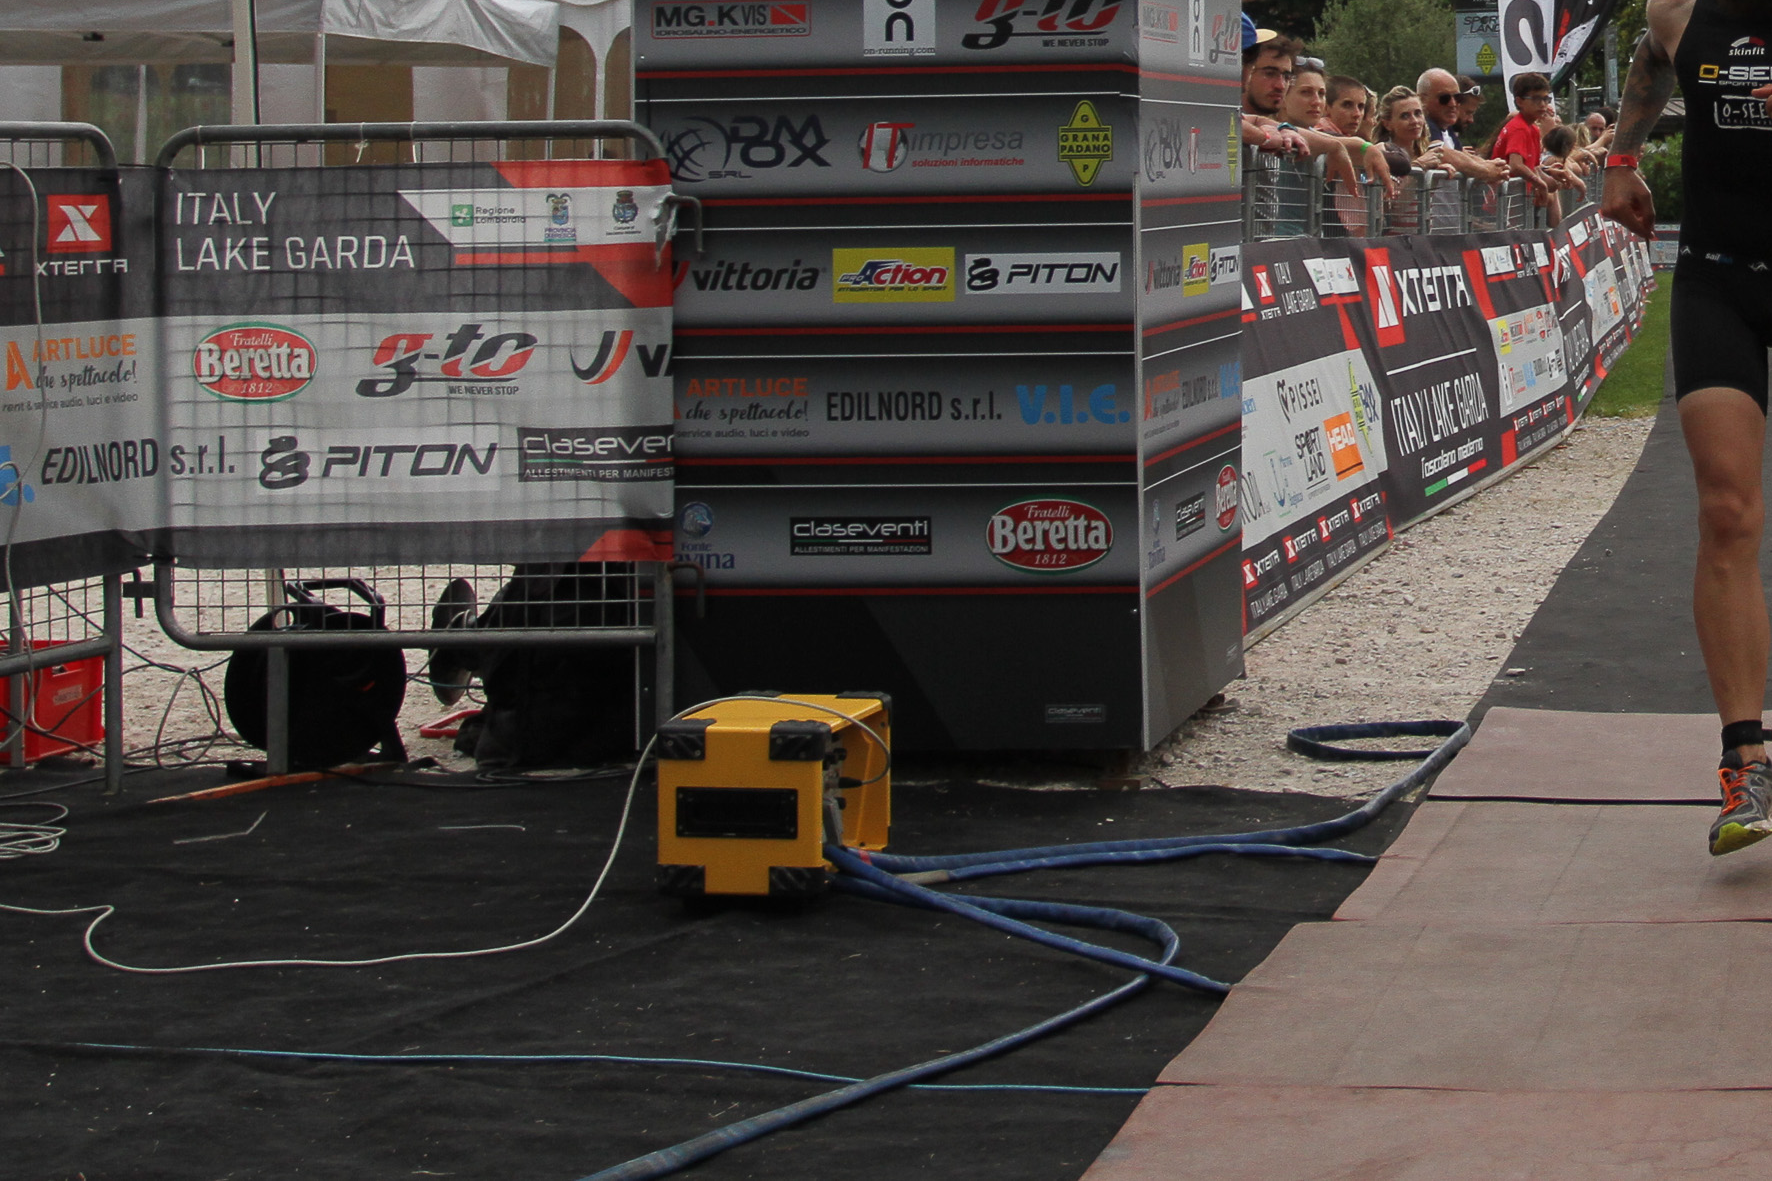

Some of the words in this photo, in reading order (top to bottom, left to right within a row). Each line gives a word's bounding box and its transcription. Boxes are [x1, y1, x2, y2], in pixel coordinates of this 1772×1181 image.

[863, 45, 937, 57] on-running.com
[1728, 46, 1765, 56] skinfit
[912, 158, 961, 168] soluzioni
[964, 156, 1025, 167] informatiche
[176, 191, 277, 226] ITALY
[176, 238, 270, 272] LAKE
[287, 235, 416, 271] GARDA
[1006, 262, 1119, 285] PITON
[1394, 265, 1472, 317] XTERRA
[61, 360, 138, 394] spettacolo!
[194, 342, 313, 382] Beretta
[686, 378, 808, 397] ARTLUCE
[1423, 380, 1460, 443] LAKE
[1453, 371, 1489, 431] GARDA
[749, 428, 768, 437] luci
[778, 427, 810, 438] video
[41, 438, 159, 486] EDILNORD
[170, 434, 236, 475] s.r.l.
[322, 441, 499, 479] PITON
[793, 520, 930, 538] claseventi
[990, 515, 1110, 554] Beretta
